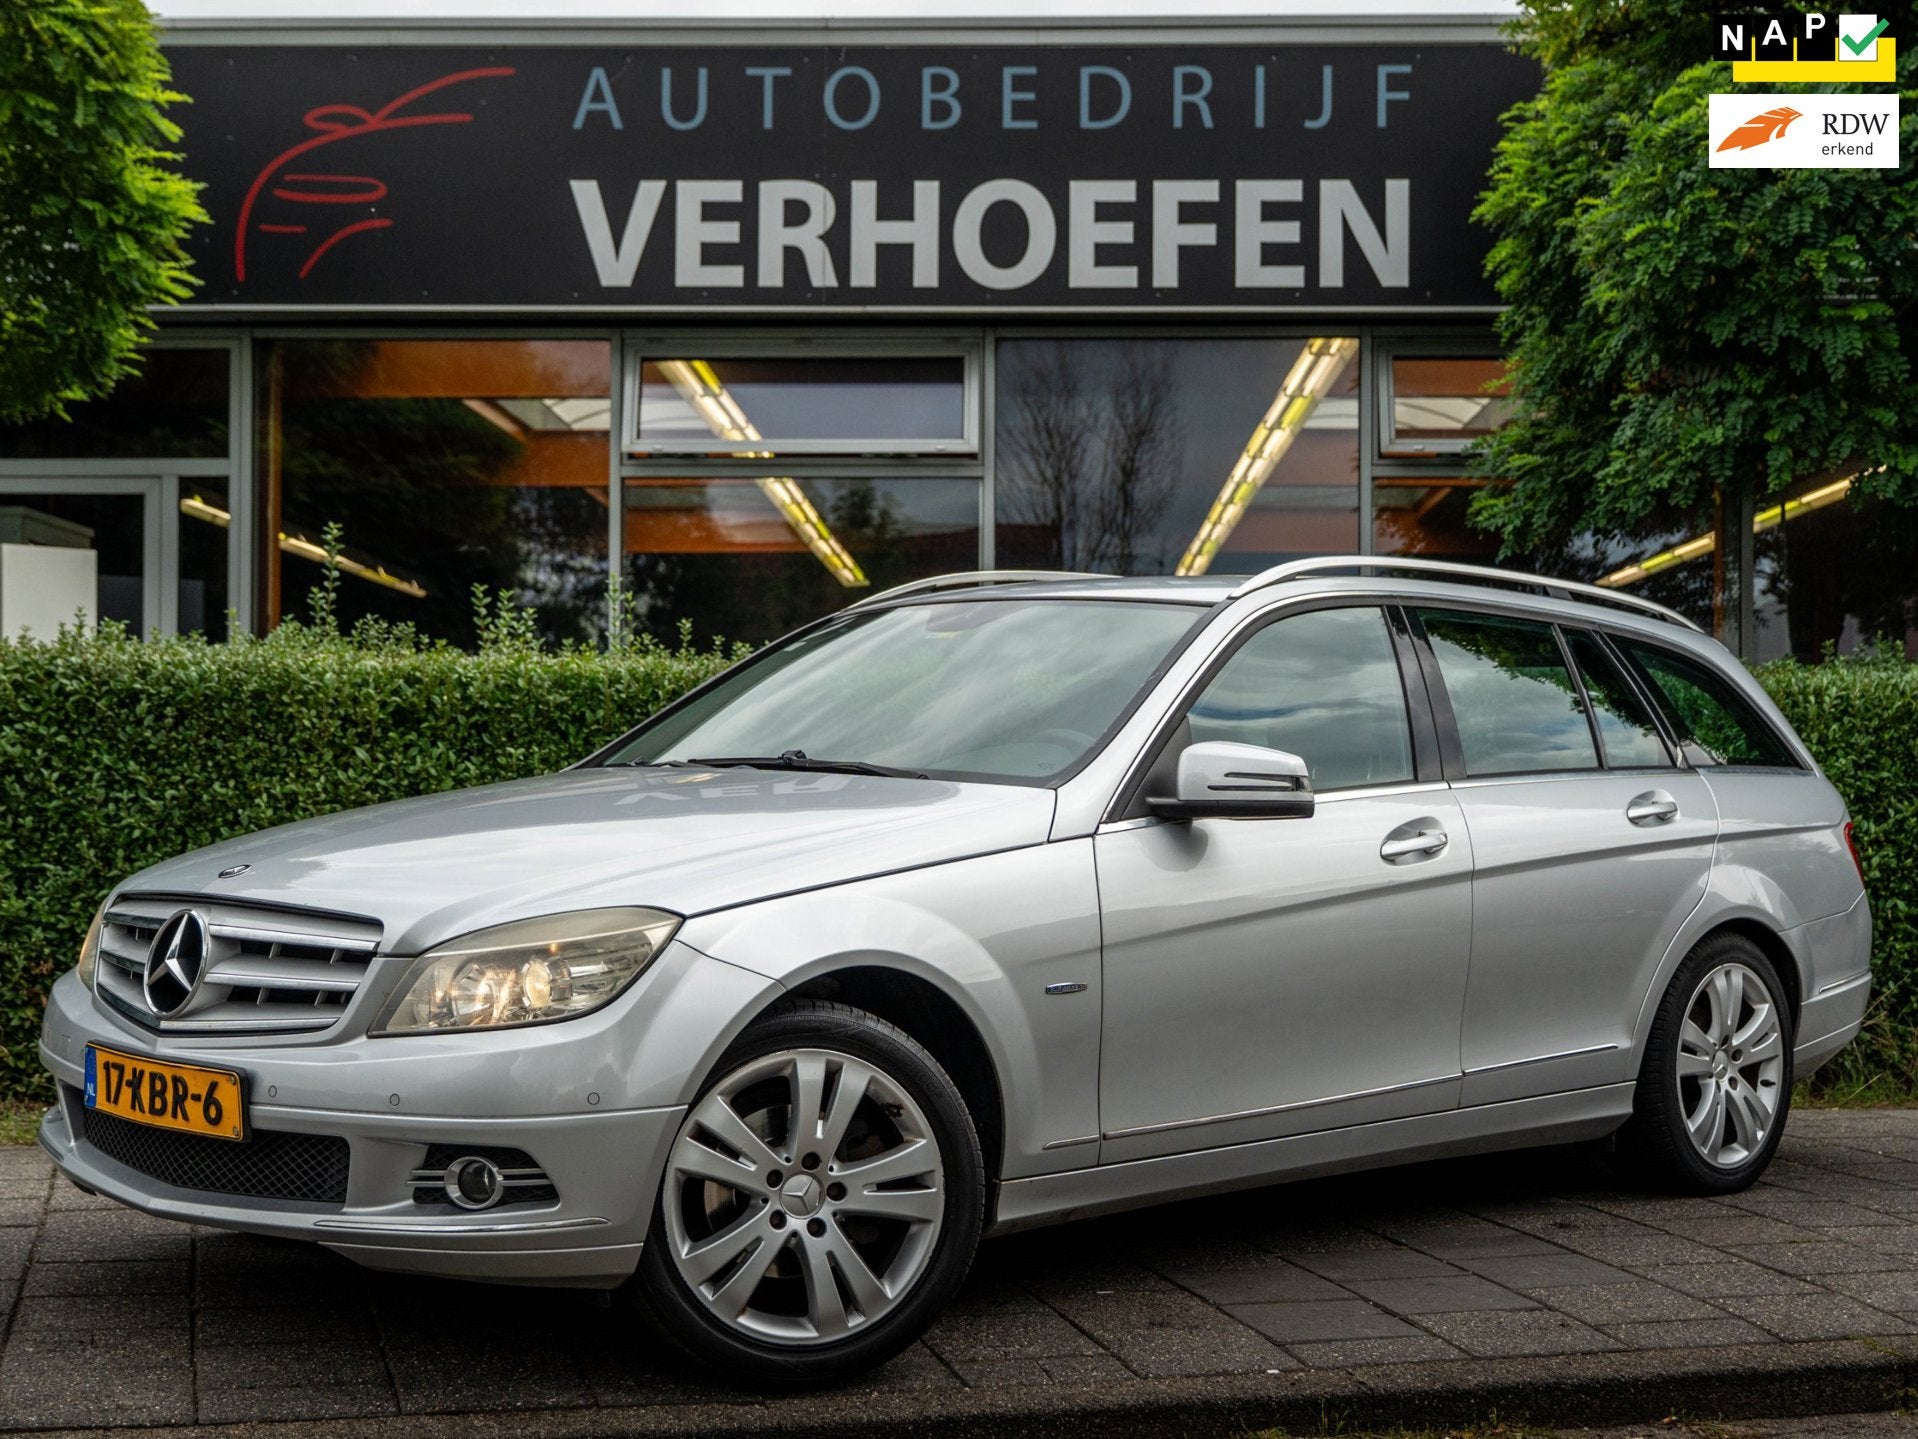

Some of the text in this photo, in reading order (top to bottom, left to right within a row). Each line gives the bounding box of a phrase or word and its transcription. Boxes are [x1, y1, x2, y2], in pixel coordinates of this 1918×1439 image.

[573, 65, 1412, 131] AUTOBEDRIJF
[568, 178, 1411, 290] VERHOEFEN
[103, 1060, 223, 1126] 17-KBR-6
